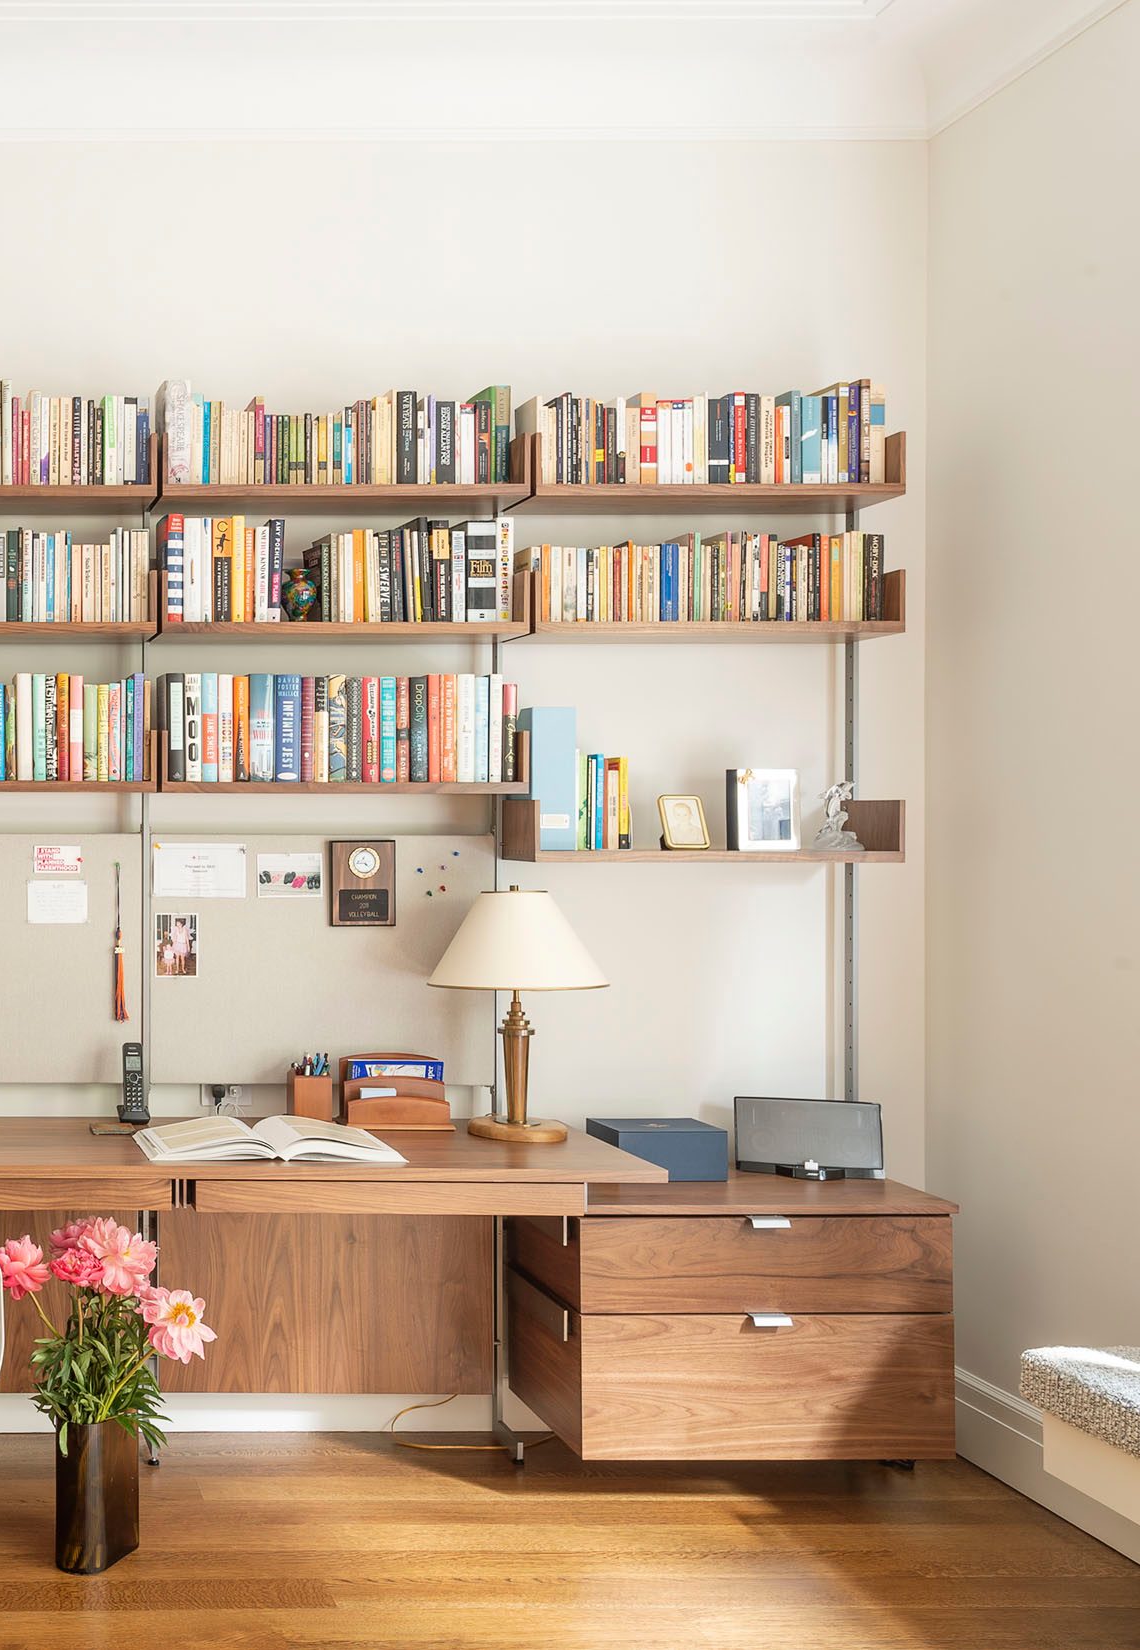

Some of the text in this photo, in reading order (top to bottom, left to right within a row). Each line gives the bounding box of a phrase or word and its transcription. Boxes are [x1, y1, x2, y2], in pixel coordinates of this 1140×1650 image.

[176, 394, 185, 451] SHAKESPEARE
[402, 409, 410, 429] YEATS
[379, 567, 389, 603] SWERVE
[206, 718, 214, 734] JANE
[282, 701, 294, 768] INFINITE JEST
